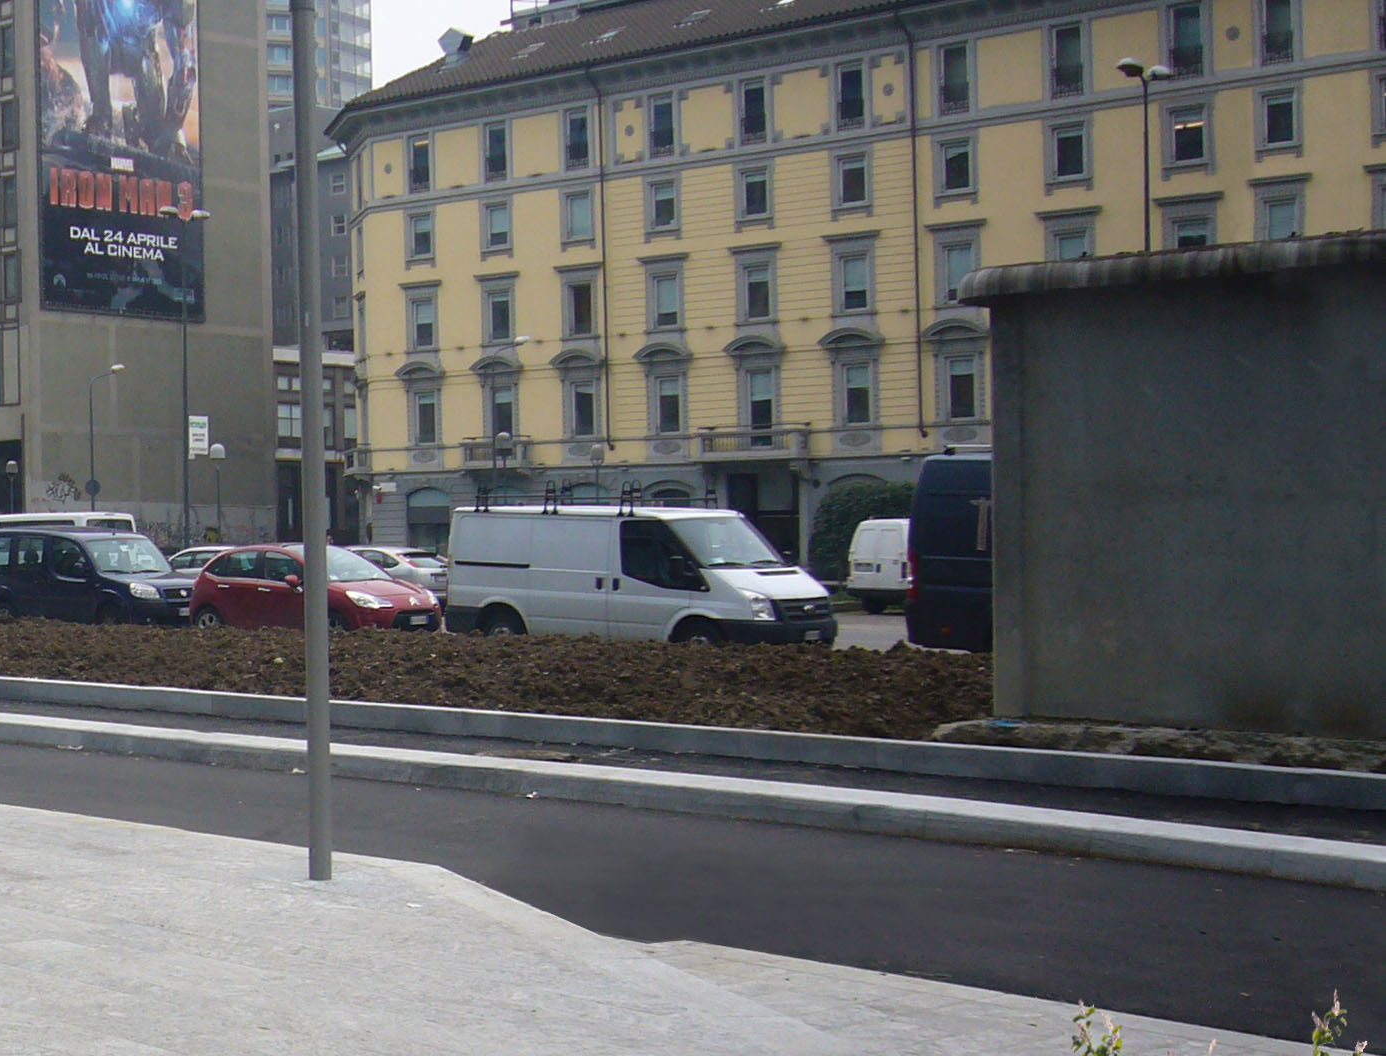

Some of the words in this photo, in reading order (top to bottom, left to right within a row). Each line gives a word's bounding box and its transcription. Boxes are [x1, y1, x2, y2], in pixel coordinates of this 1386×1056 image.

[49, 167, 112, 211] IRON
[119, 174, 173, 218] MAN
[177, 180, 194, 222] 3
[69, 225, 101, 242] DAL
[103, 230, 124, 244] 24
[126, 231, 179, 250] APRILE
[83, 241, 105, 256] AL
[107, 244, 165, 262] CINEMA
